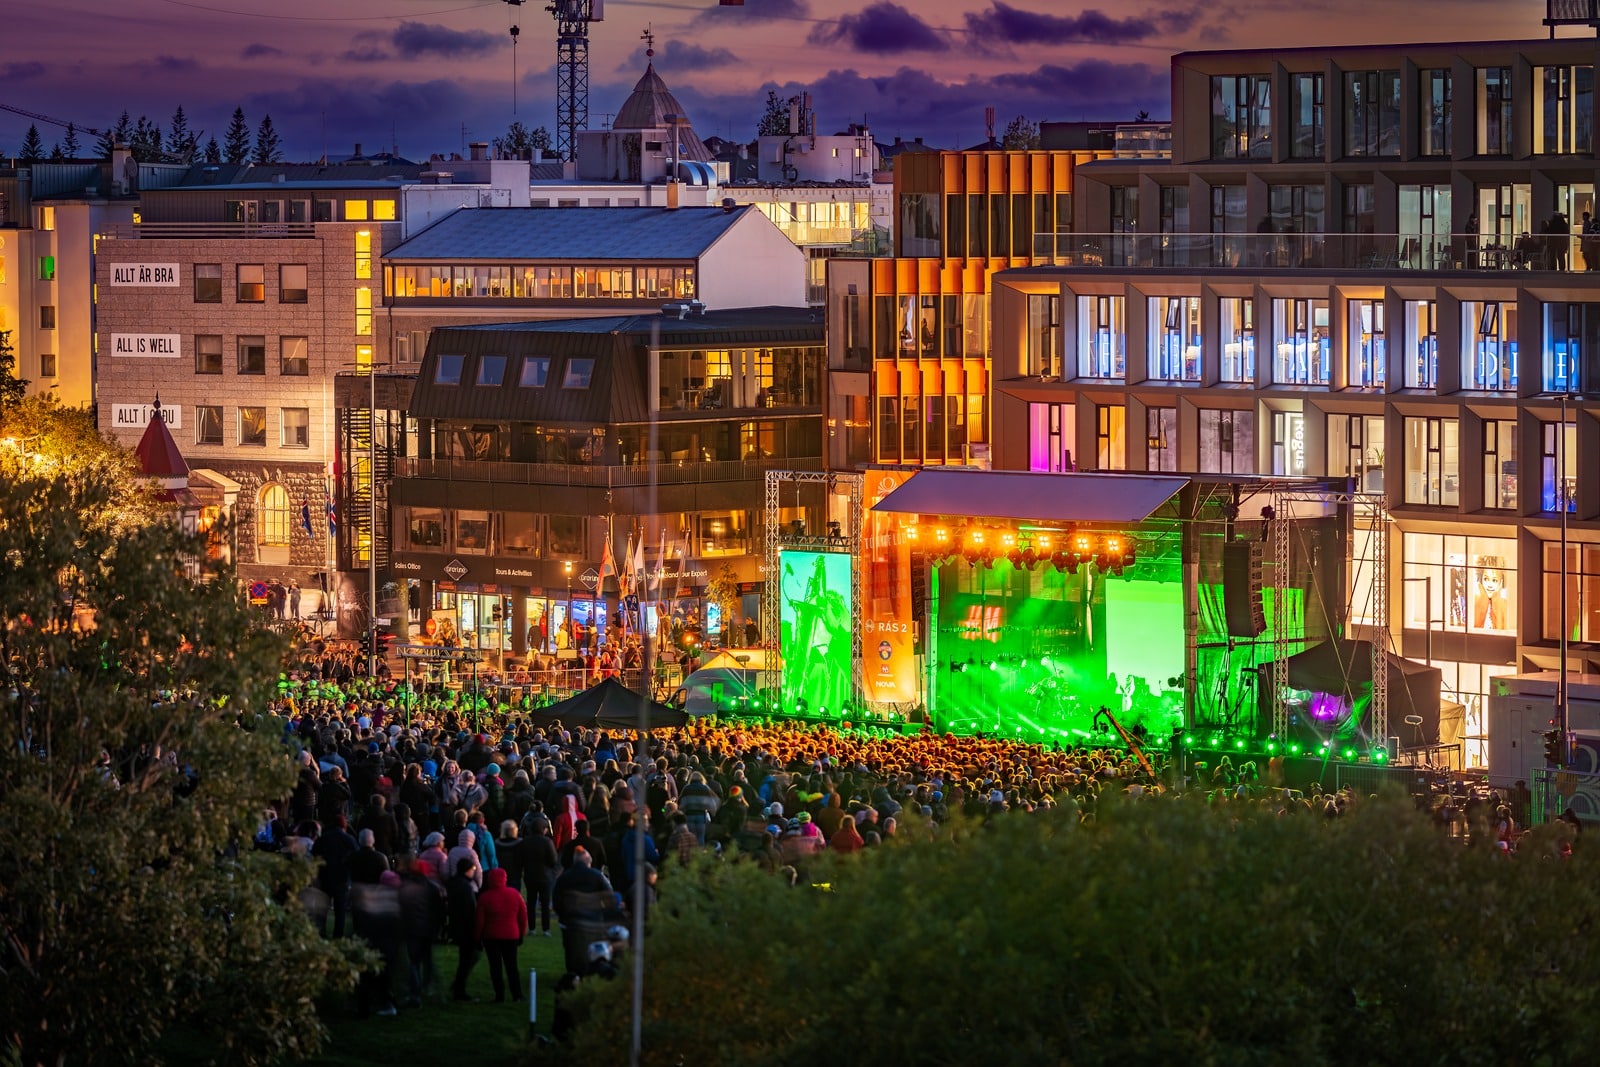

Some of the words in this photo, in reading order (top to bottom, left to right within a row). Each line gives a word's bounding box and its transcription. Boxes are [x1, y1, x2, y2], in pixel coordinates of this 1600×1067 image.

[115, 268, 135, 282] ALLT
[139, 265, 152, 282] ÄR
[155, 268, 174, 282] BRA
[117, 338, 133, 352] ALL
[137, 338, 146, 352] IS
[150, 338, 174, 353] WELL
[118, 409, 138, 423] ALLT
[143, 406, 147, 423] Í
[150, 409, 174, 424] OÐU
[394, 562, 407, 570] Sales
[407, 562, 421, 570] Office
[495, 568, 508, 576] Tours
[511, 569, 533, 577] Activities
[691, 570, 708, 578] Expert
[878, 620, 899, 633] RÁS
[901, 623, 907, 633] 2
